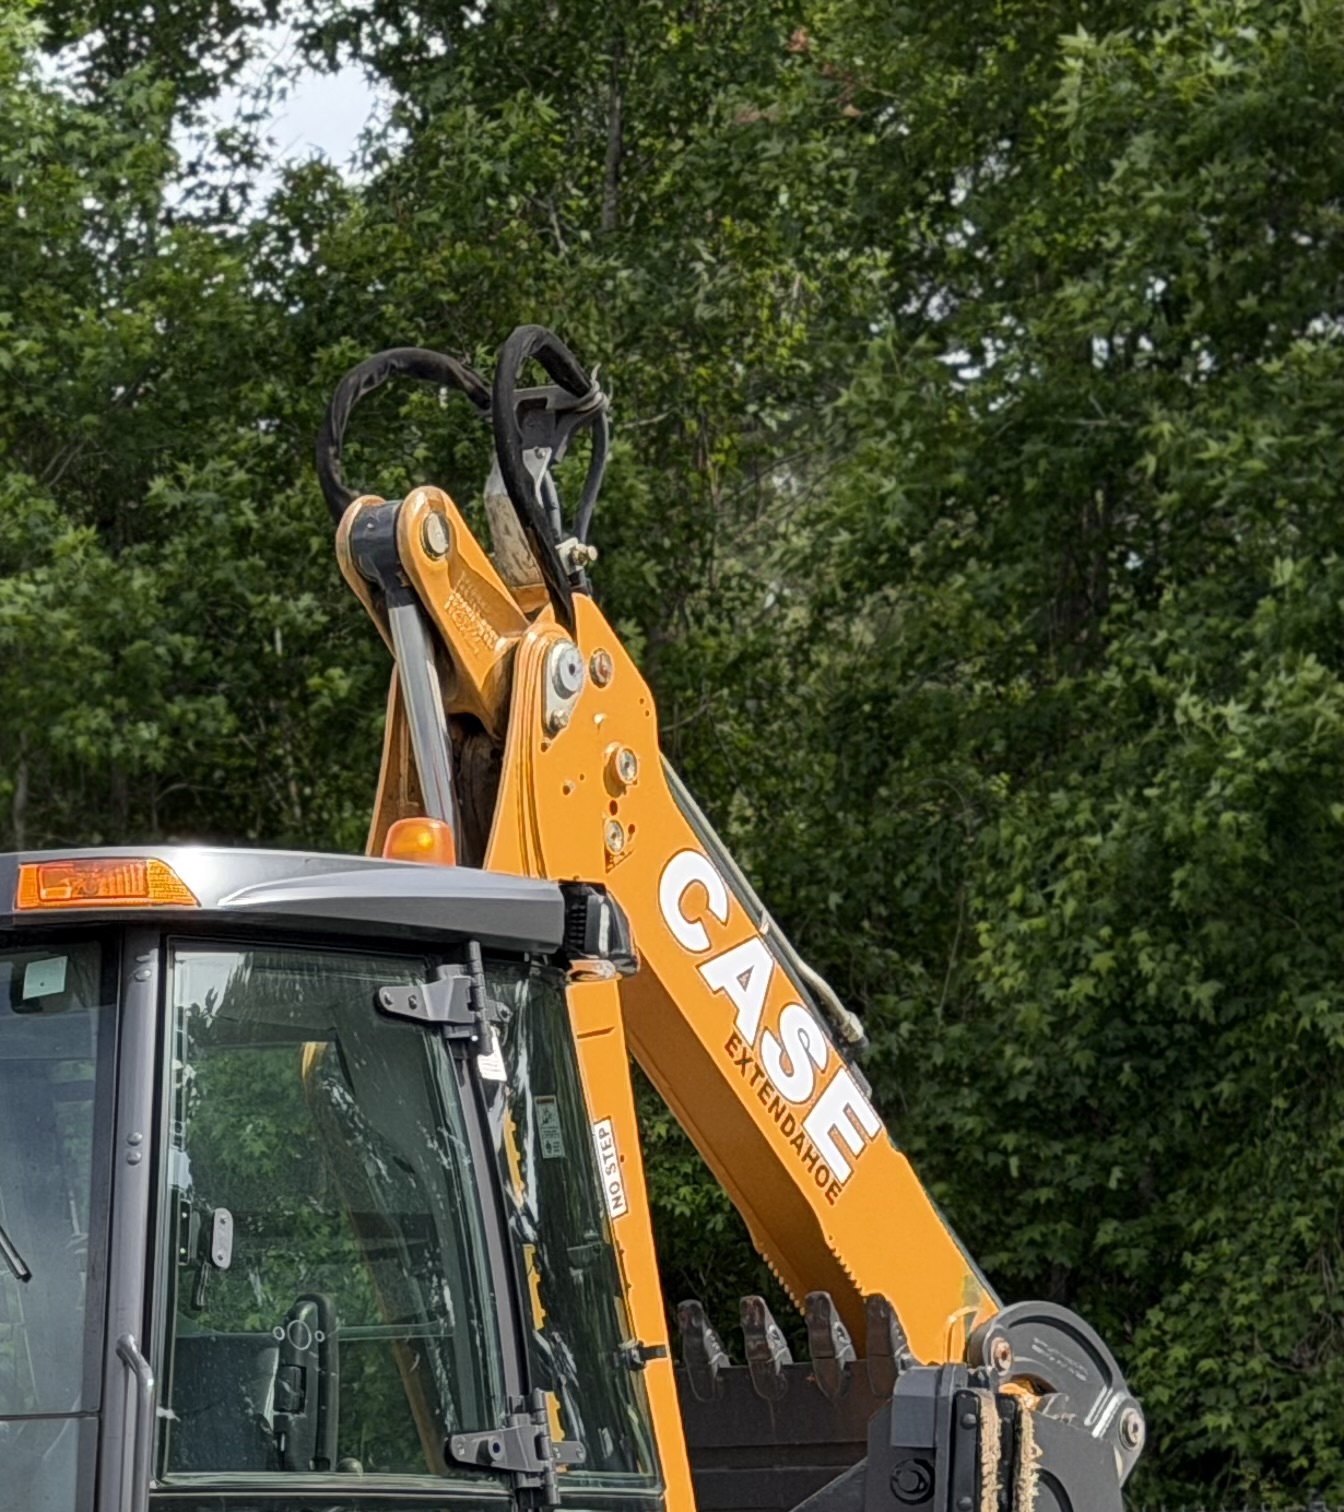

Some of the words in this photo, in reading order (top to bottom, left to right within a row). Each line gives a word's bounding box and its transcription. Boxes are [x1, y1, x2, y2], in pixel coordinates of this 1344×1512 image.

[658, 848, 883, 1188] CASE
[598, 1127, 617, 1176] STEP
[724, 1033, 843, 1207] EXTENDAHOE
[608, 1181, 624, 1211] NO
